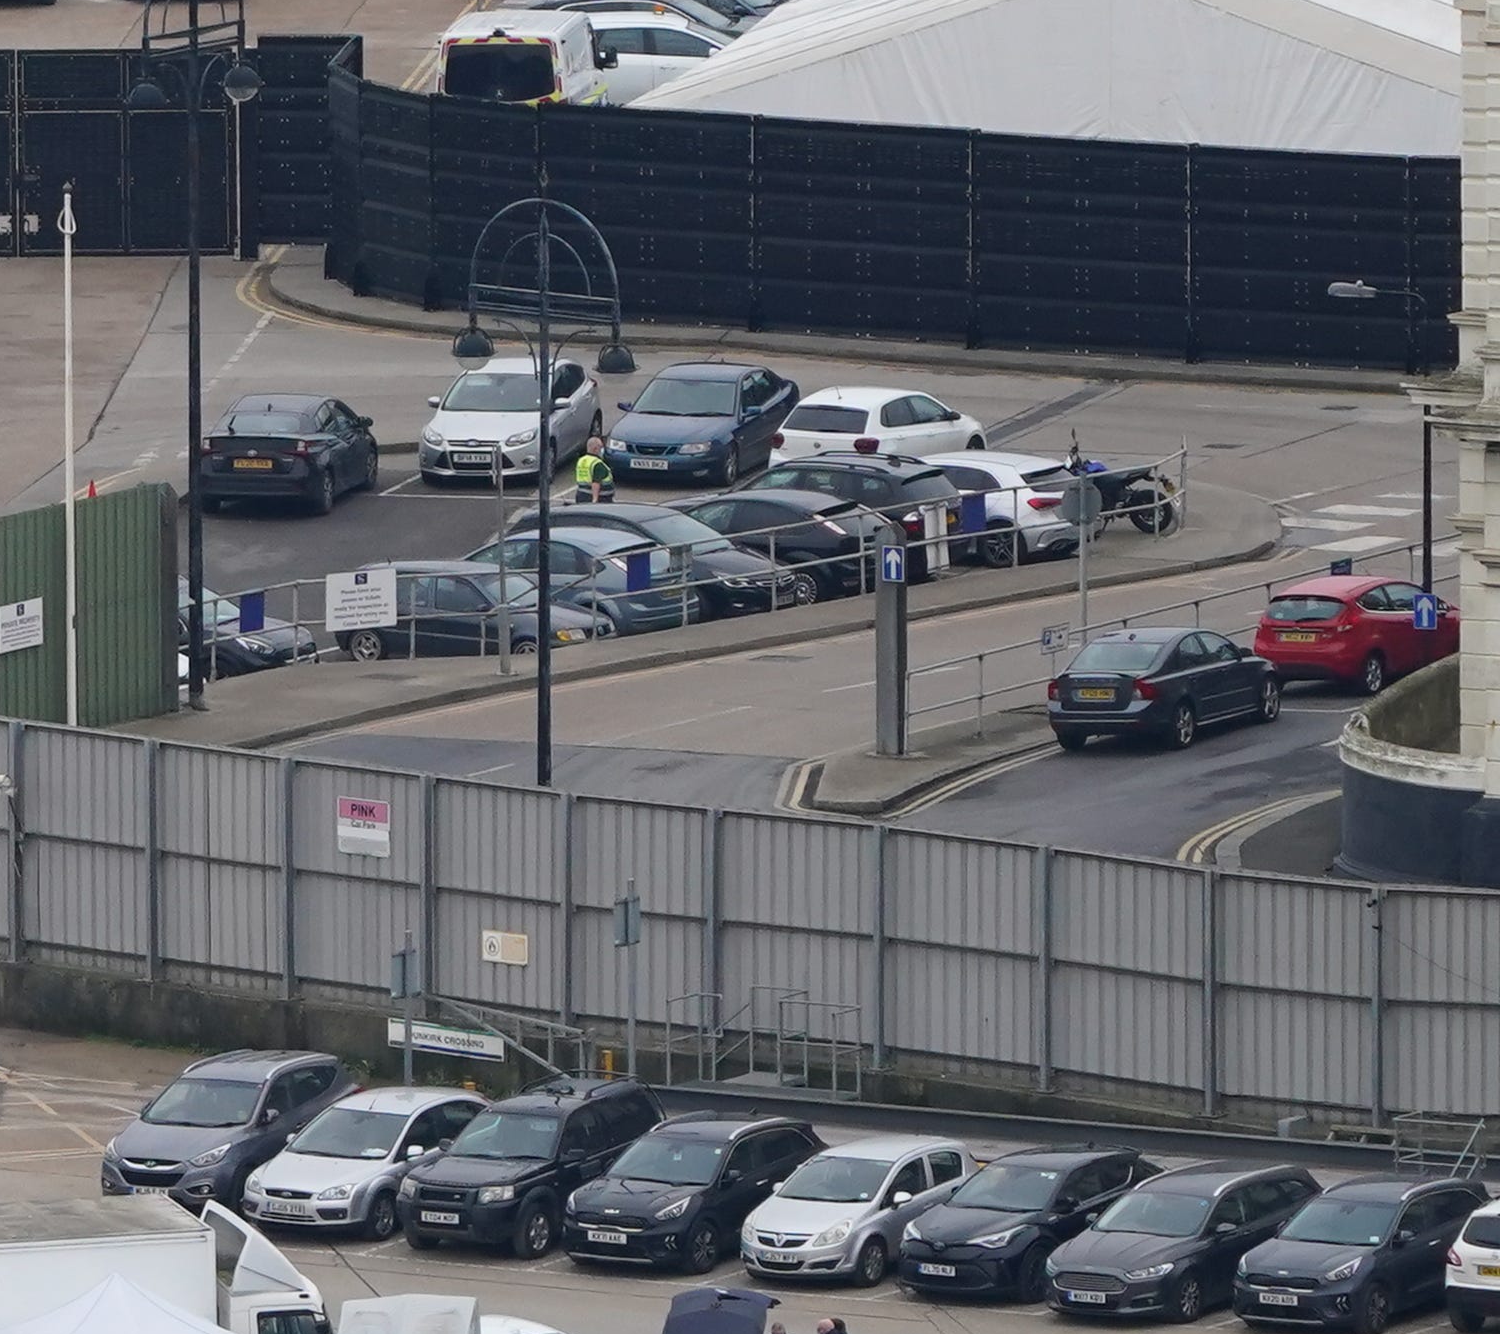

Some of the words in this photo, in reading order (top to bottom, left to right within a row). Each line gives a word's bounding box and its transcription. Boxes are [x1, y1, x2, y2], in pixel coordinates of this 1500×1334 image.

[350, 803, 376, 818] PINK
[351, 819, 360, 828] Car
[362, 820, 376, 830] Park
[409, 1030, 443, 1043] UNKIRK
[444, 1034, 485, 1049] CROSSING
